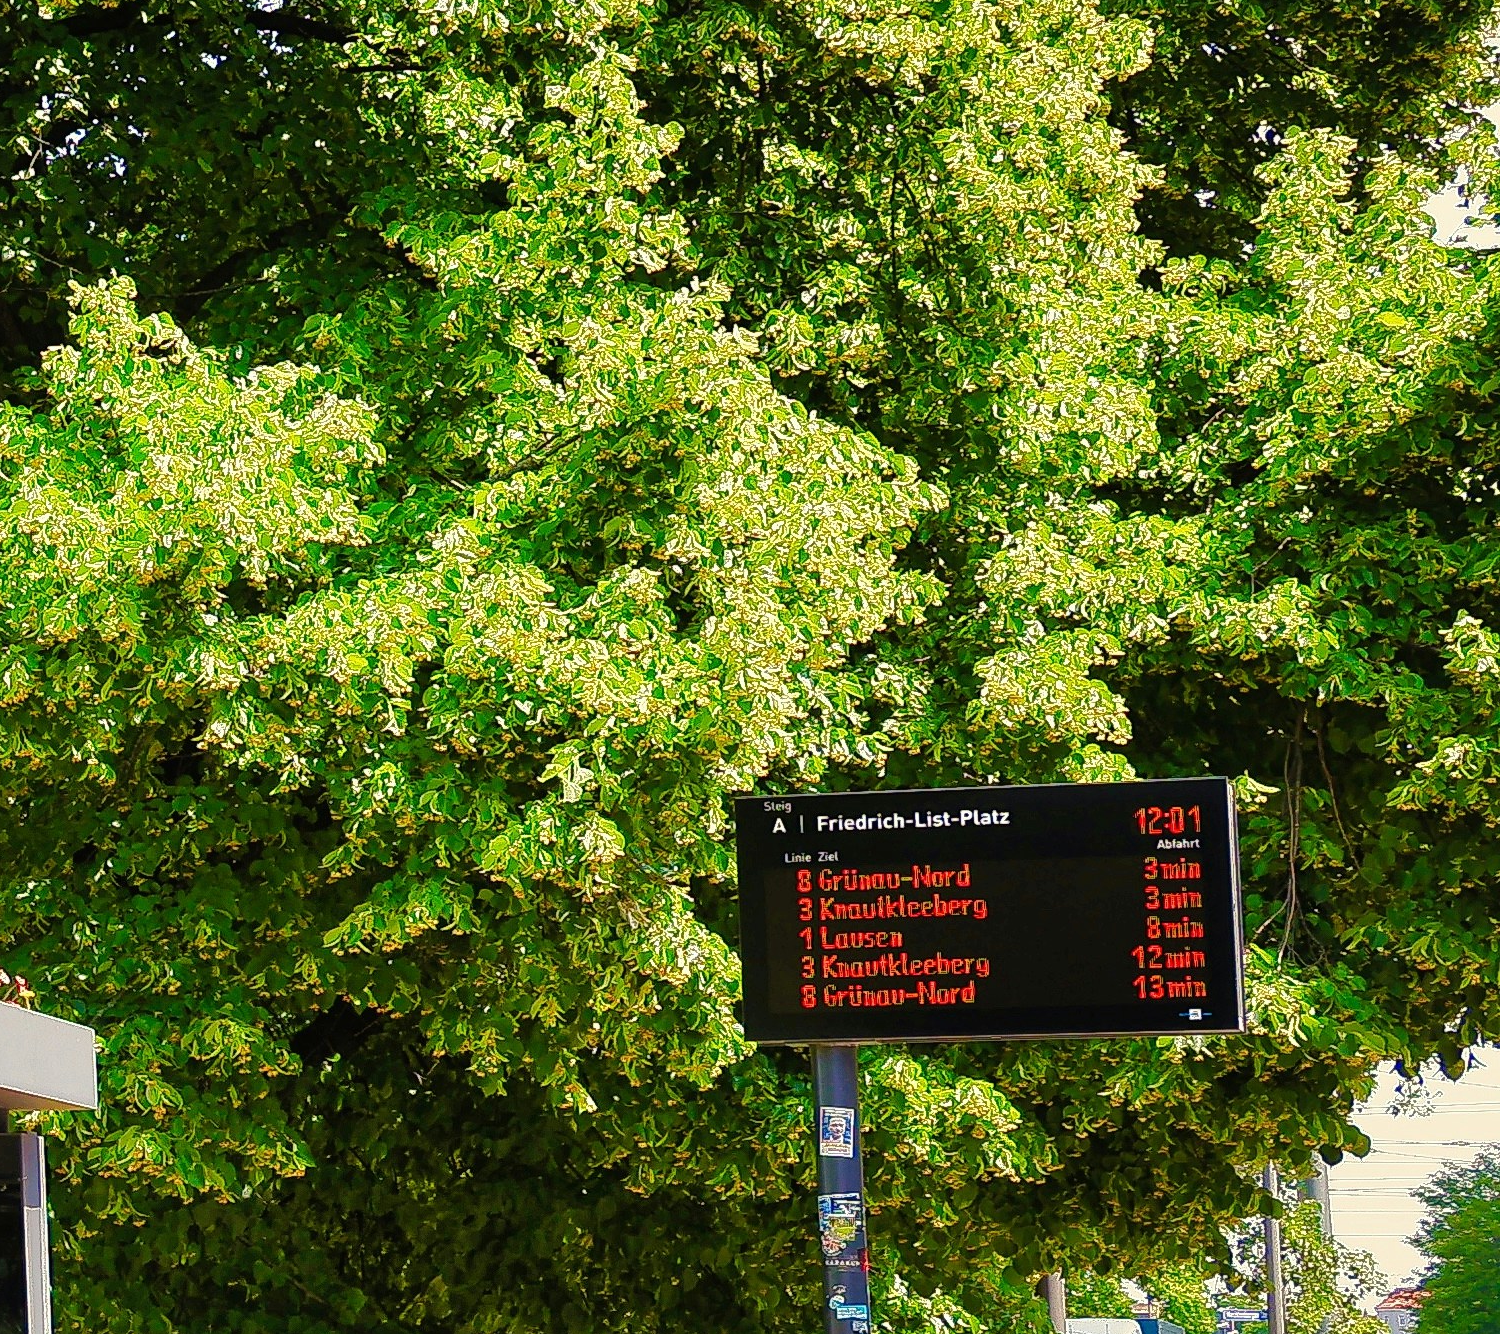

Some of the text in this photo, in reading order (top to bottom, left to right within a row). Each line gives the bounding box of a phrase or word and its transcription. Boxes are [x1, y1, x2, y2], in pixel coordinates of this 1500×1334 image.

[764, 801, 792, 813] Steig
[772, 809, 1011, 834] A Friedrich-List-Platz
[1133, 805, 1201, 835] 12:01
[1156, 838, 1201, 849] Abfahrt
[784, 852, 812, 863] Linie
[817, 851, 839, 862] Ziel
[818, 863, 971, 892] Grünau-Nord
[799, 894, 988, 921] 3 Knautkleeberg
[799, 926, 903, 950] 1 Lausen
[801, 952, 990, 979] 3 Knautkleeberg
[1131, 945, 1163, 969] 12
[823, 980, 976, 1007] Grünau-Nord
[1133, 974, 1165, 999] 13
